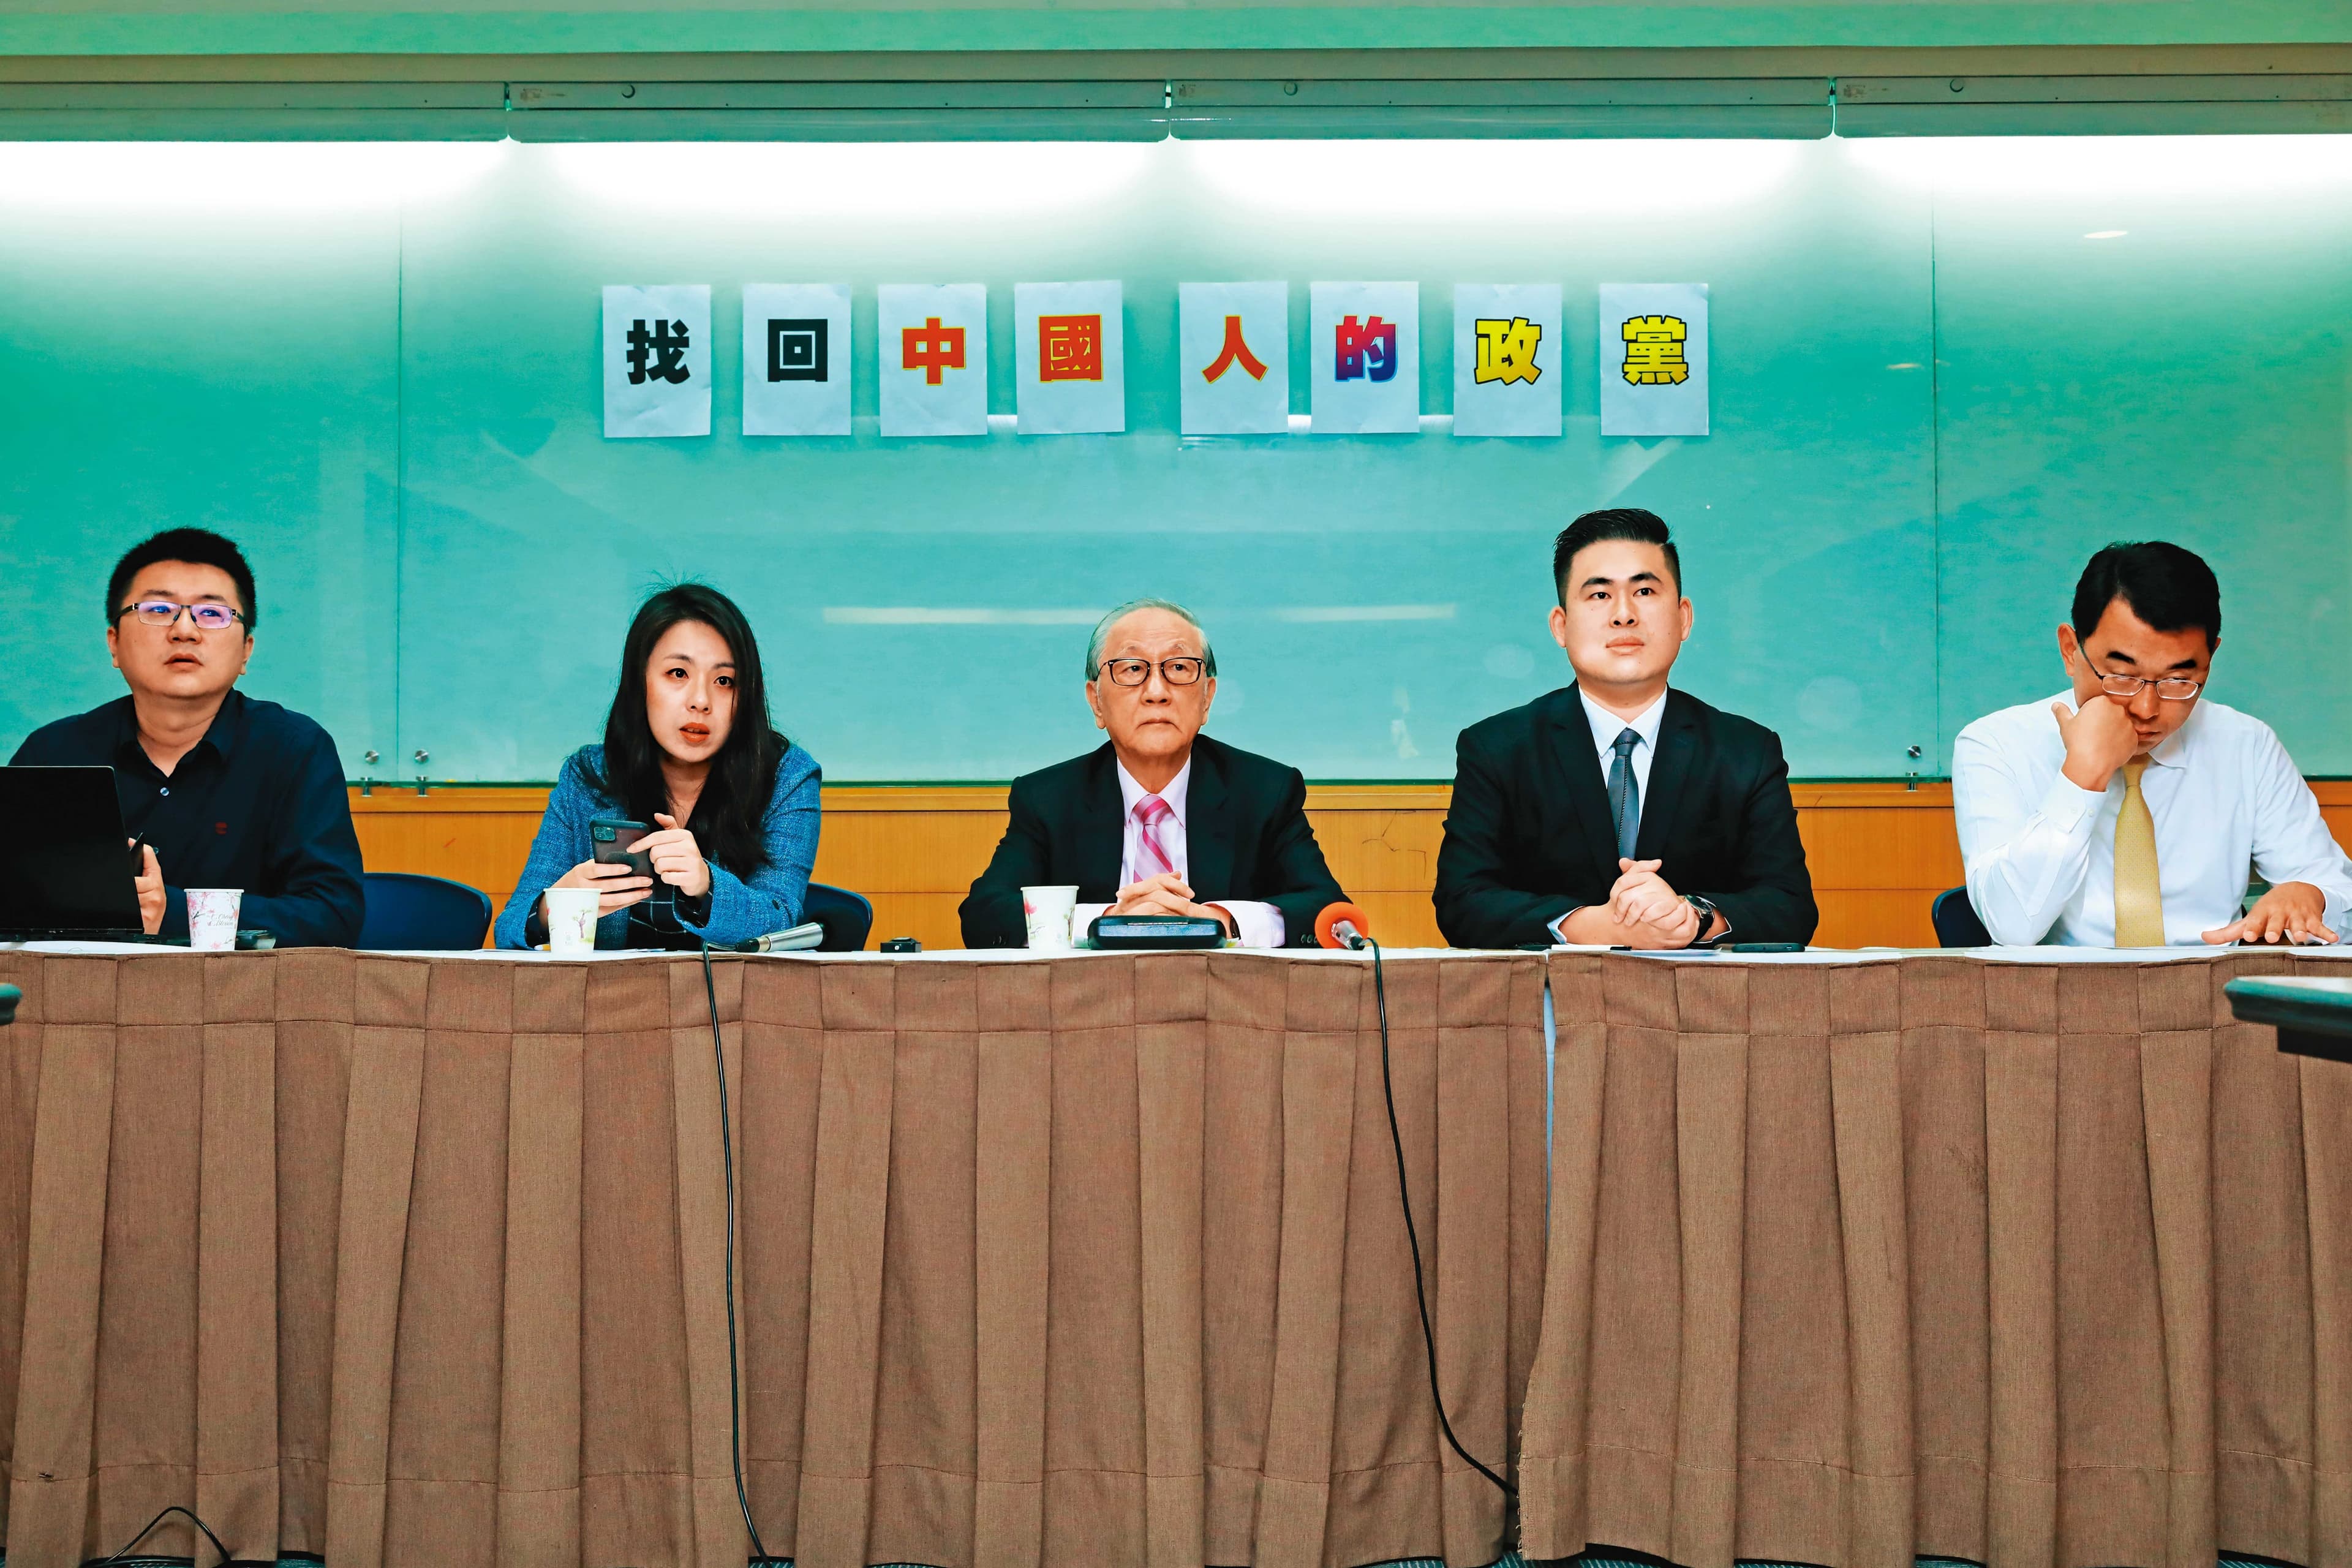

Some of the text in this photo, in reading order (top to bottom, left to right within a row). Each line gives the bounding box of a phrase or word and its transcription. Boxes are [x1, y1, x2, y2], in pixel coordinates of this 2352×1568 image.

[626, 313, 1689, 386] 找回中國人的政黨
